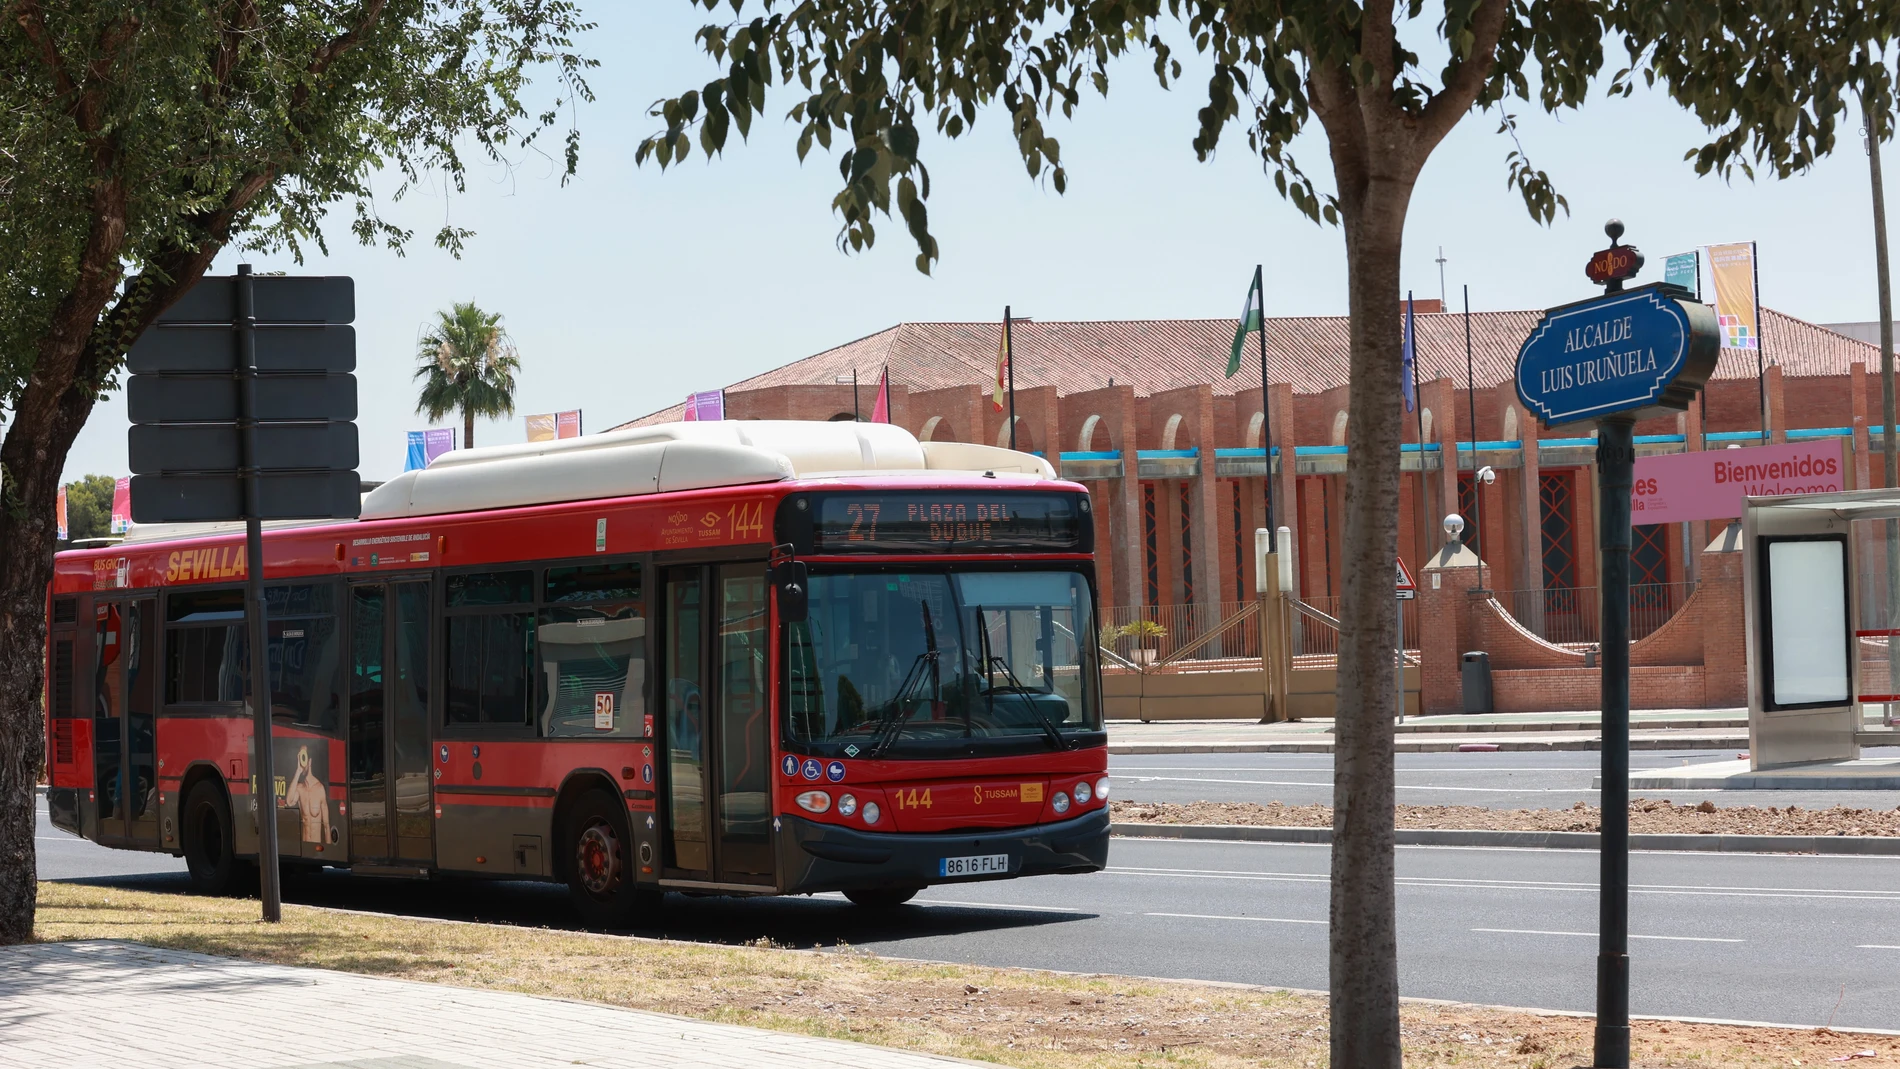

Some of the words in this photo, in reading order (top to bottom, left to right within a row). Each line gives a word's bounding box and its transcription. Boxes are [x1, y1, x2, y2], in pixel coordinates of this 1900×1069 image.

[1564, 316, 1632, 353] ALCALDE
[1541, 365, 1573, 394] LUIS
[1576, 347, 1657, 386] URUÑUELA
[1714, 454, 1837, 484] Bienvenidos
[727, 502, 764, 540] 144
[847, 504, 880, 541] 27
[907, 504, 966, 521] PLAZA
[977, 504, 1010, 521] DEL
[698, 529, 721, 537] TUSSAM
[930, 523, 992, 541] DUQUE
[93, 559, 106, 571] BUS
[166, 546, 245, 582] SEVILLA
[596, 695, 612, 715] 50
[895, 788, 933, 810] 144
[985, 789, 1018, 799] TUSSAM
[947, 858, 979, 873] 8616
[982, 856, 1005, 871] FLH
